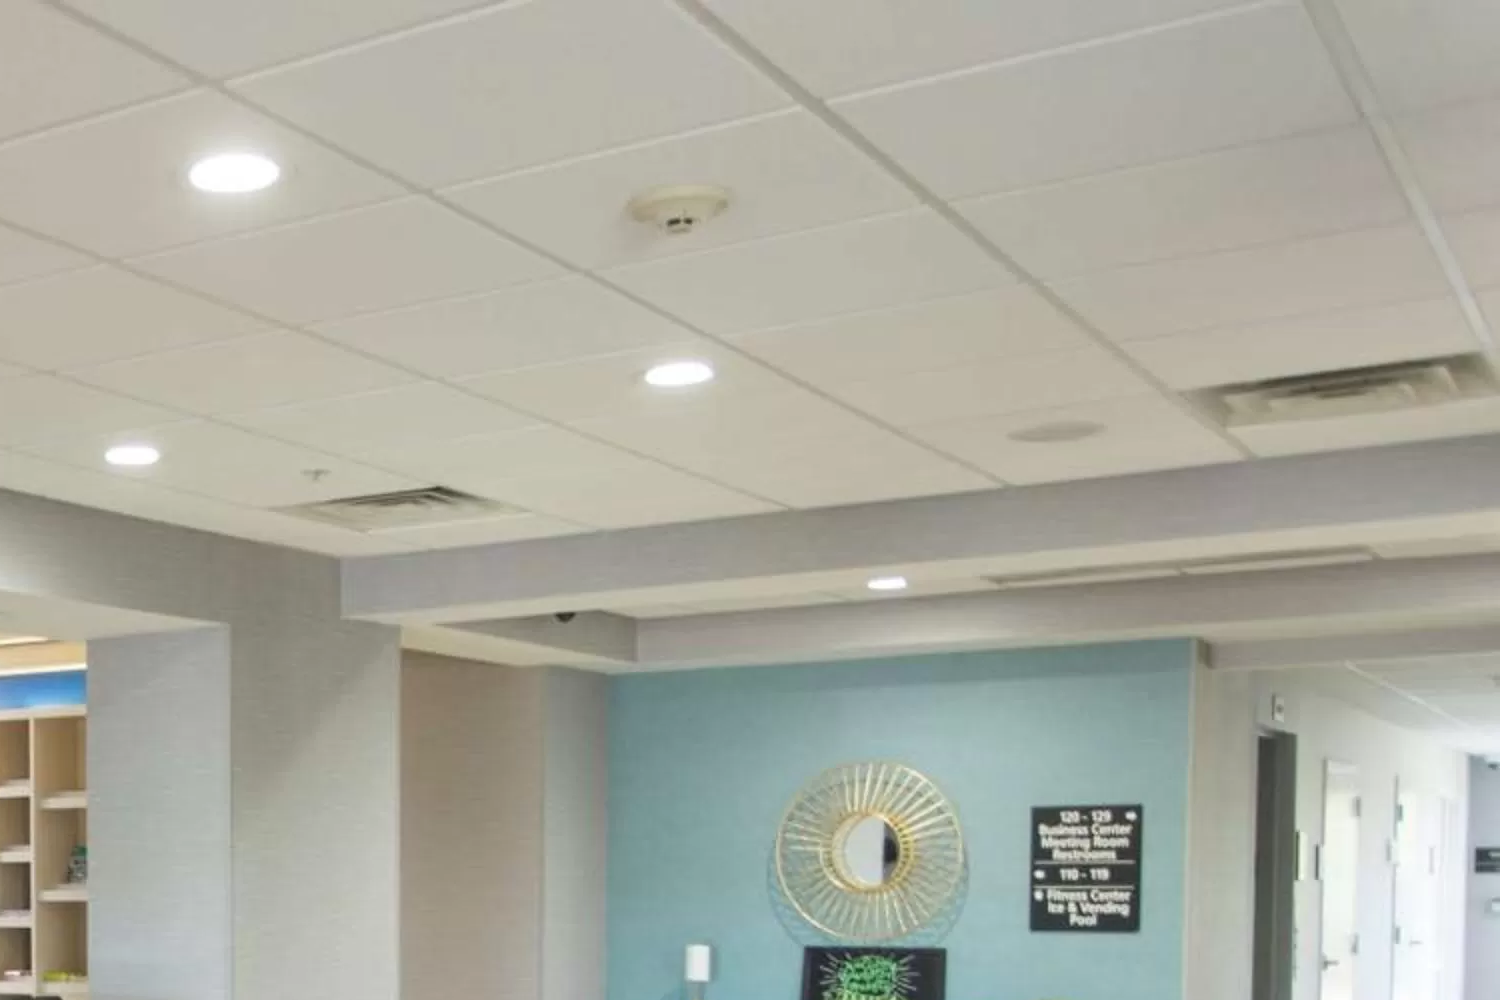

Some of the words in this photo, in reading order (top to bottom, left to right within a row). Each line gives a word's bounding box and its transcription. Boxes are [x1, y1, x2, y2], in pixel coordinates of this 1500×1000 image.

[1038, 823, 1088, 836] Business
[1092, 823, 1132, 836] Center
[1041, 836, 1090, 850] Meeting
[1093, 836, 1129, 848] Room
[1053, 849, 1116, 860] Restrooms
[1047, 888, 1088, 901] Fitness
[1091, 889, 1131, 902] Center
[1047, 902, 1065, 913] Ice
[1080, 901, 1130, 918] Vending
[1069, 913, 1098, 926] Pool
